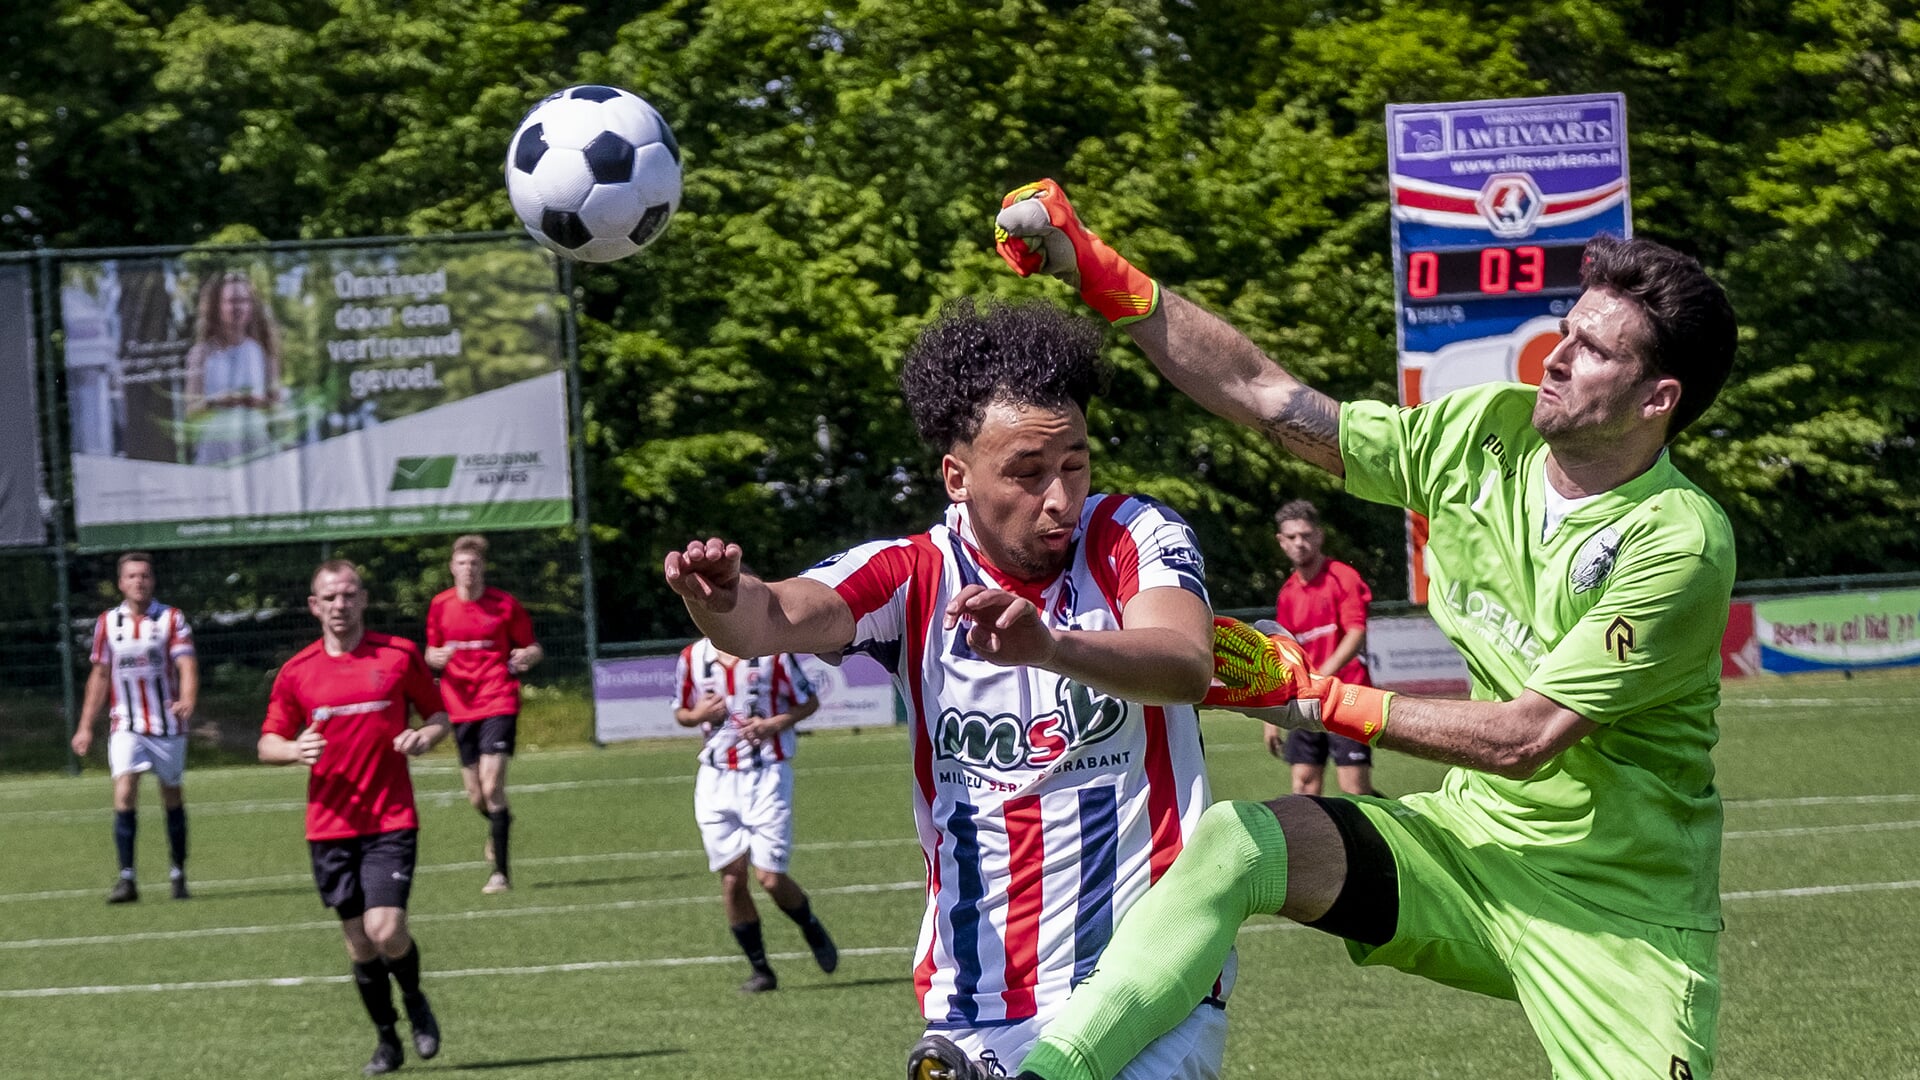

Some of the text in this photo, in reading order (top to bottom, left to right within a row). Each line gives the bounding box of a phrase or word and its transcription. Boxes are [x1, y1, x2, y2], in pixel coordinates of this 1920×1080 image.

[334, 267, 447, 300] Omringd
[1408, 246, 1545, 298] 0 03
[335, 303, 449, 330] door een
[327, 328, 462, 363] vertrouwd
[350, 361, 444, 398] gevoel.
[939, 771, 983, 788] MILIEU
[1052, 750, 1131, 775] BRABANT
